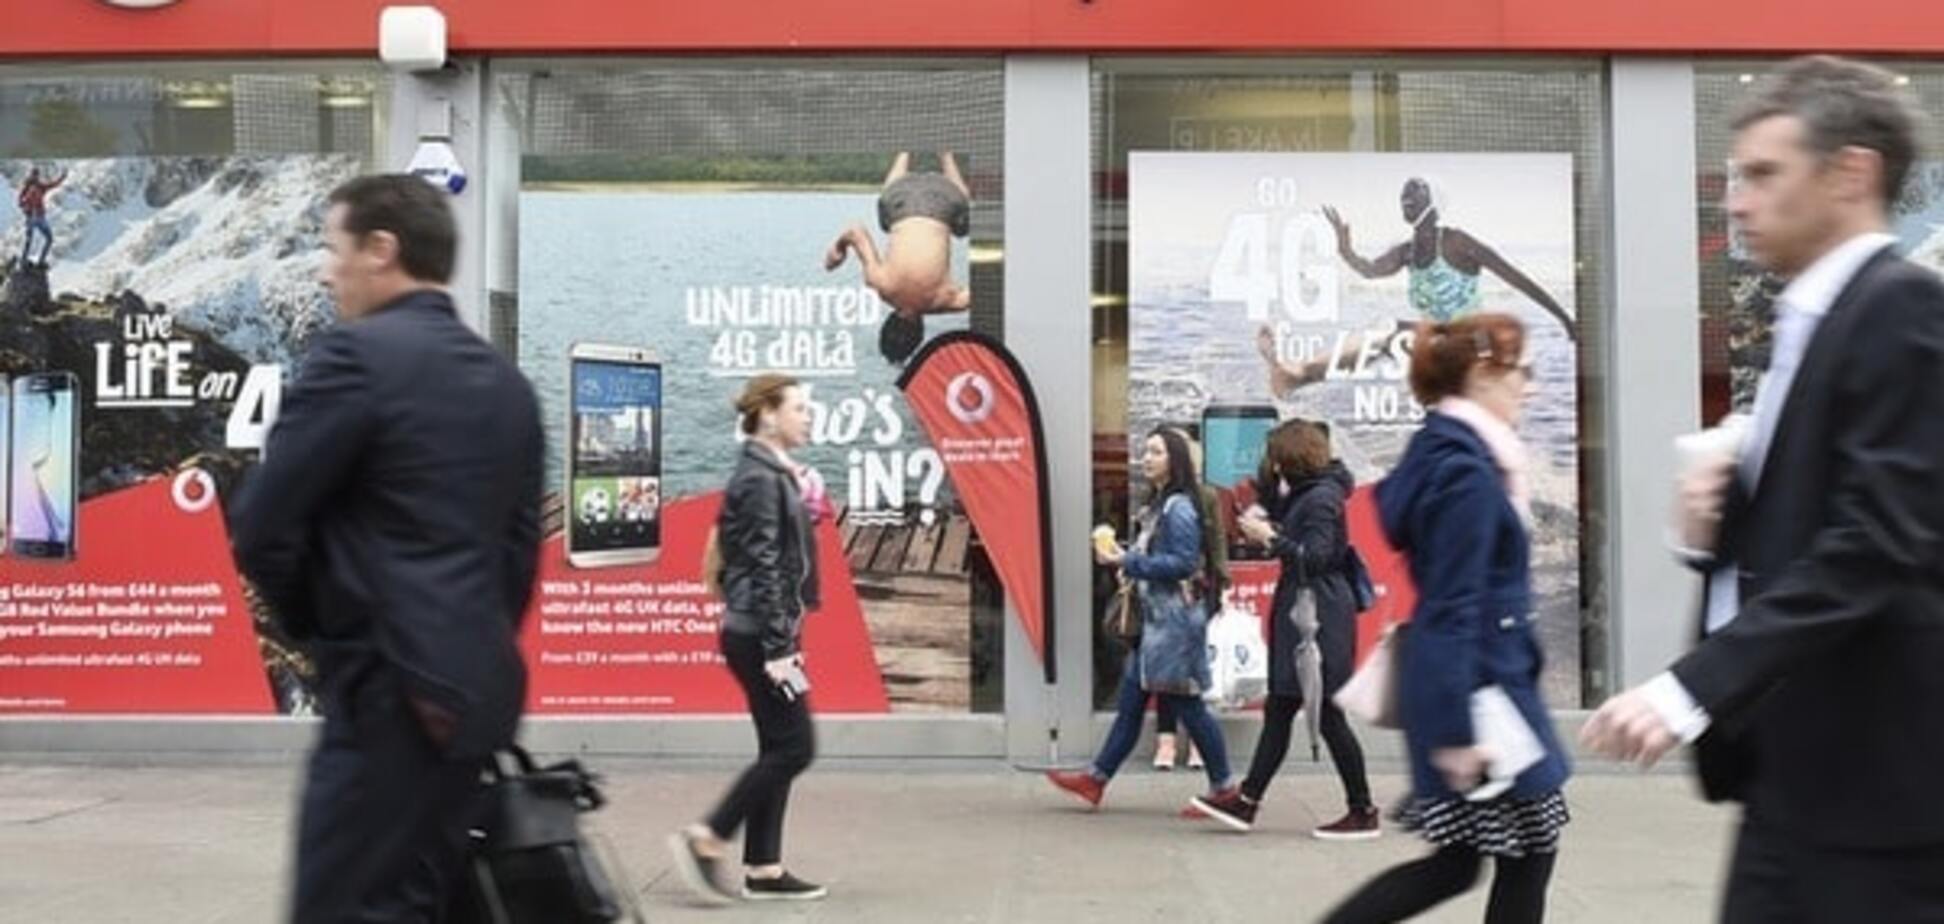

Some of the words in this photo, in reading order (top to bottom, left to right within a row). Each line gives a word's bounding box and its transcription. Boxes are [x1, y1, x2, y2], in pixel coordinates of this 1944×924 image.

[1258, 177, 1296, 207] GO
[1210, 212, 1338, 323] 4G
[711, 330, 756, 368] 4G
[1275, 321, 1322, 364] for
[198, 371, 238, 400] on
[1354, 385, 1399, 420] NO
[12, 582, 64, 601] Galaxy
[87, 583, 125, 598] from
[170, 582, 221, 597] month
[593, 581, 653, 596] months
[51, 602, 95, 617] Value
[97, 602, 150, 617] Bundle
[154, 602, 195, 617] when
[197, 605, 227, 620] you
[37, 621, 108, 640] Samsung
[110, 620, 162, 640] Galaxy
[651, 619, 683, 634] HTC
[684, 619, 717, 634] One
